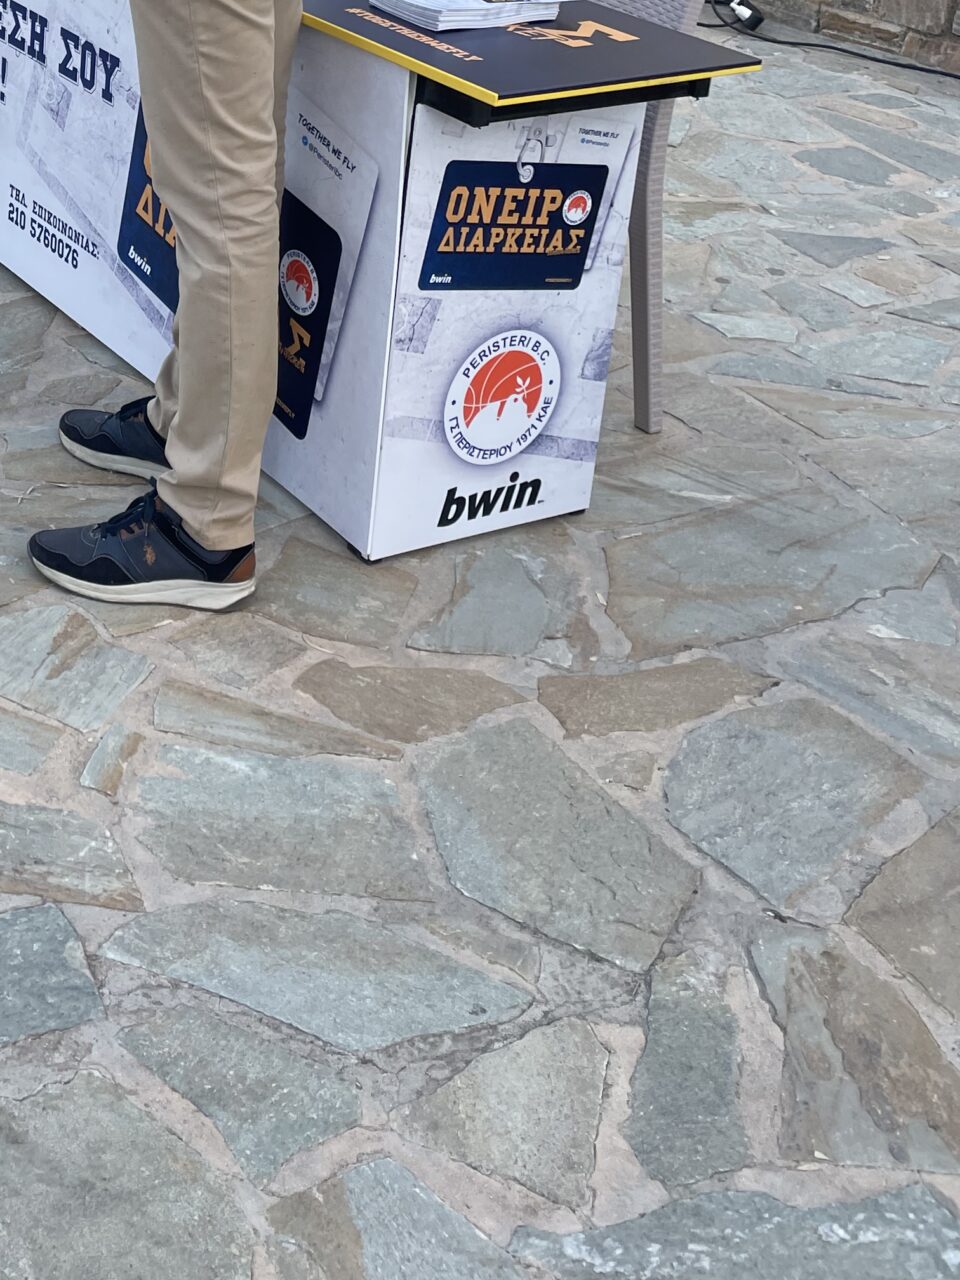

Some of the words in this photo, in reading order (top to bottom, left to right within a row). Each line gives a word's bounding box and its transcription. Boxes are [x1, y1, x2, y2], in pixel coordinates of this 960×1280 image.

[58, 26, 122, 104] ΣΟΥ
[298, 112, 332, 153] TOGETHER
[331, 144, 343, 161] WE
[342, 156, 357, 174] FLY
[8, 202, 27, 231] 210
[29, 216, 80, 270] 5760076
[127, 245, 153, 276] bwin
[437, 226, 586, 255] ΔΙΑΡΚΕΙΑΣ
[429, 273, 452, 284] bwin
[463, 335, 531, 379] PERISTERI
[531, 340, 550, 366] B.C.
[452, 431, 514, 460] ΠΕΡΙΣΤΕΡΙΟΥ
[515, 423, 538, 447] 1971
[535, 395, 554, 424] ΚΑΕ
[437, 471, 543, 528] bwin
